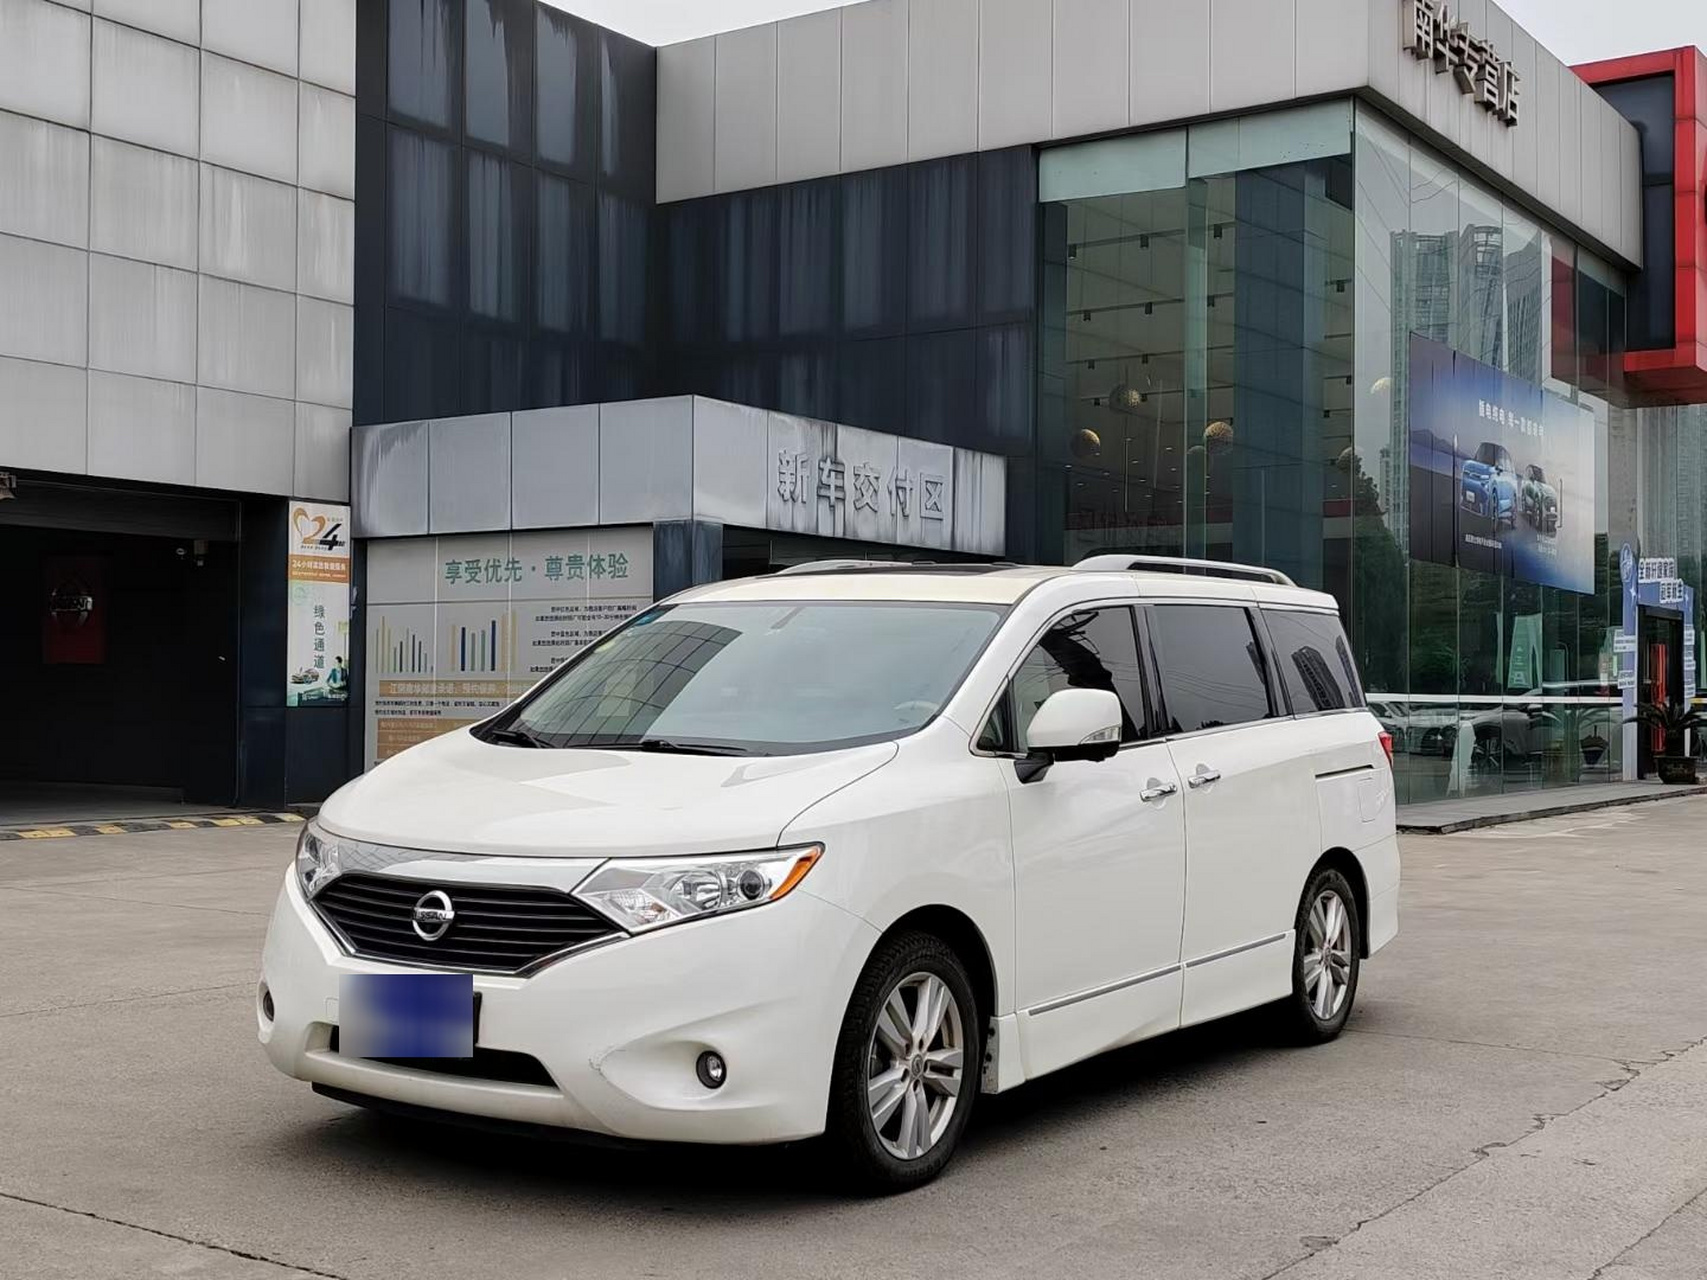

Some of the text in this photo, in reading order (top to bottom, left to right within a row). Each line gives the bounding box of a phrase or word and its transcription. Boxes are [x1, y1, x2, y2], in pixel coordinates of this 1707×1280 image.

[1405, 0, 1519, 127] 南华专营店
[777, 449, 945, 520] 新车交付区
[444, 552, 629, 585] 享受优先·尊贵体验
[313, 604, 326, 669] 绿色通道
